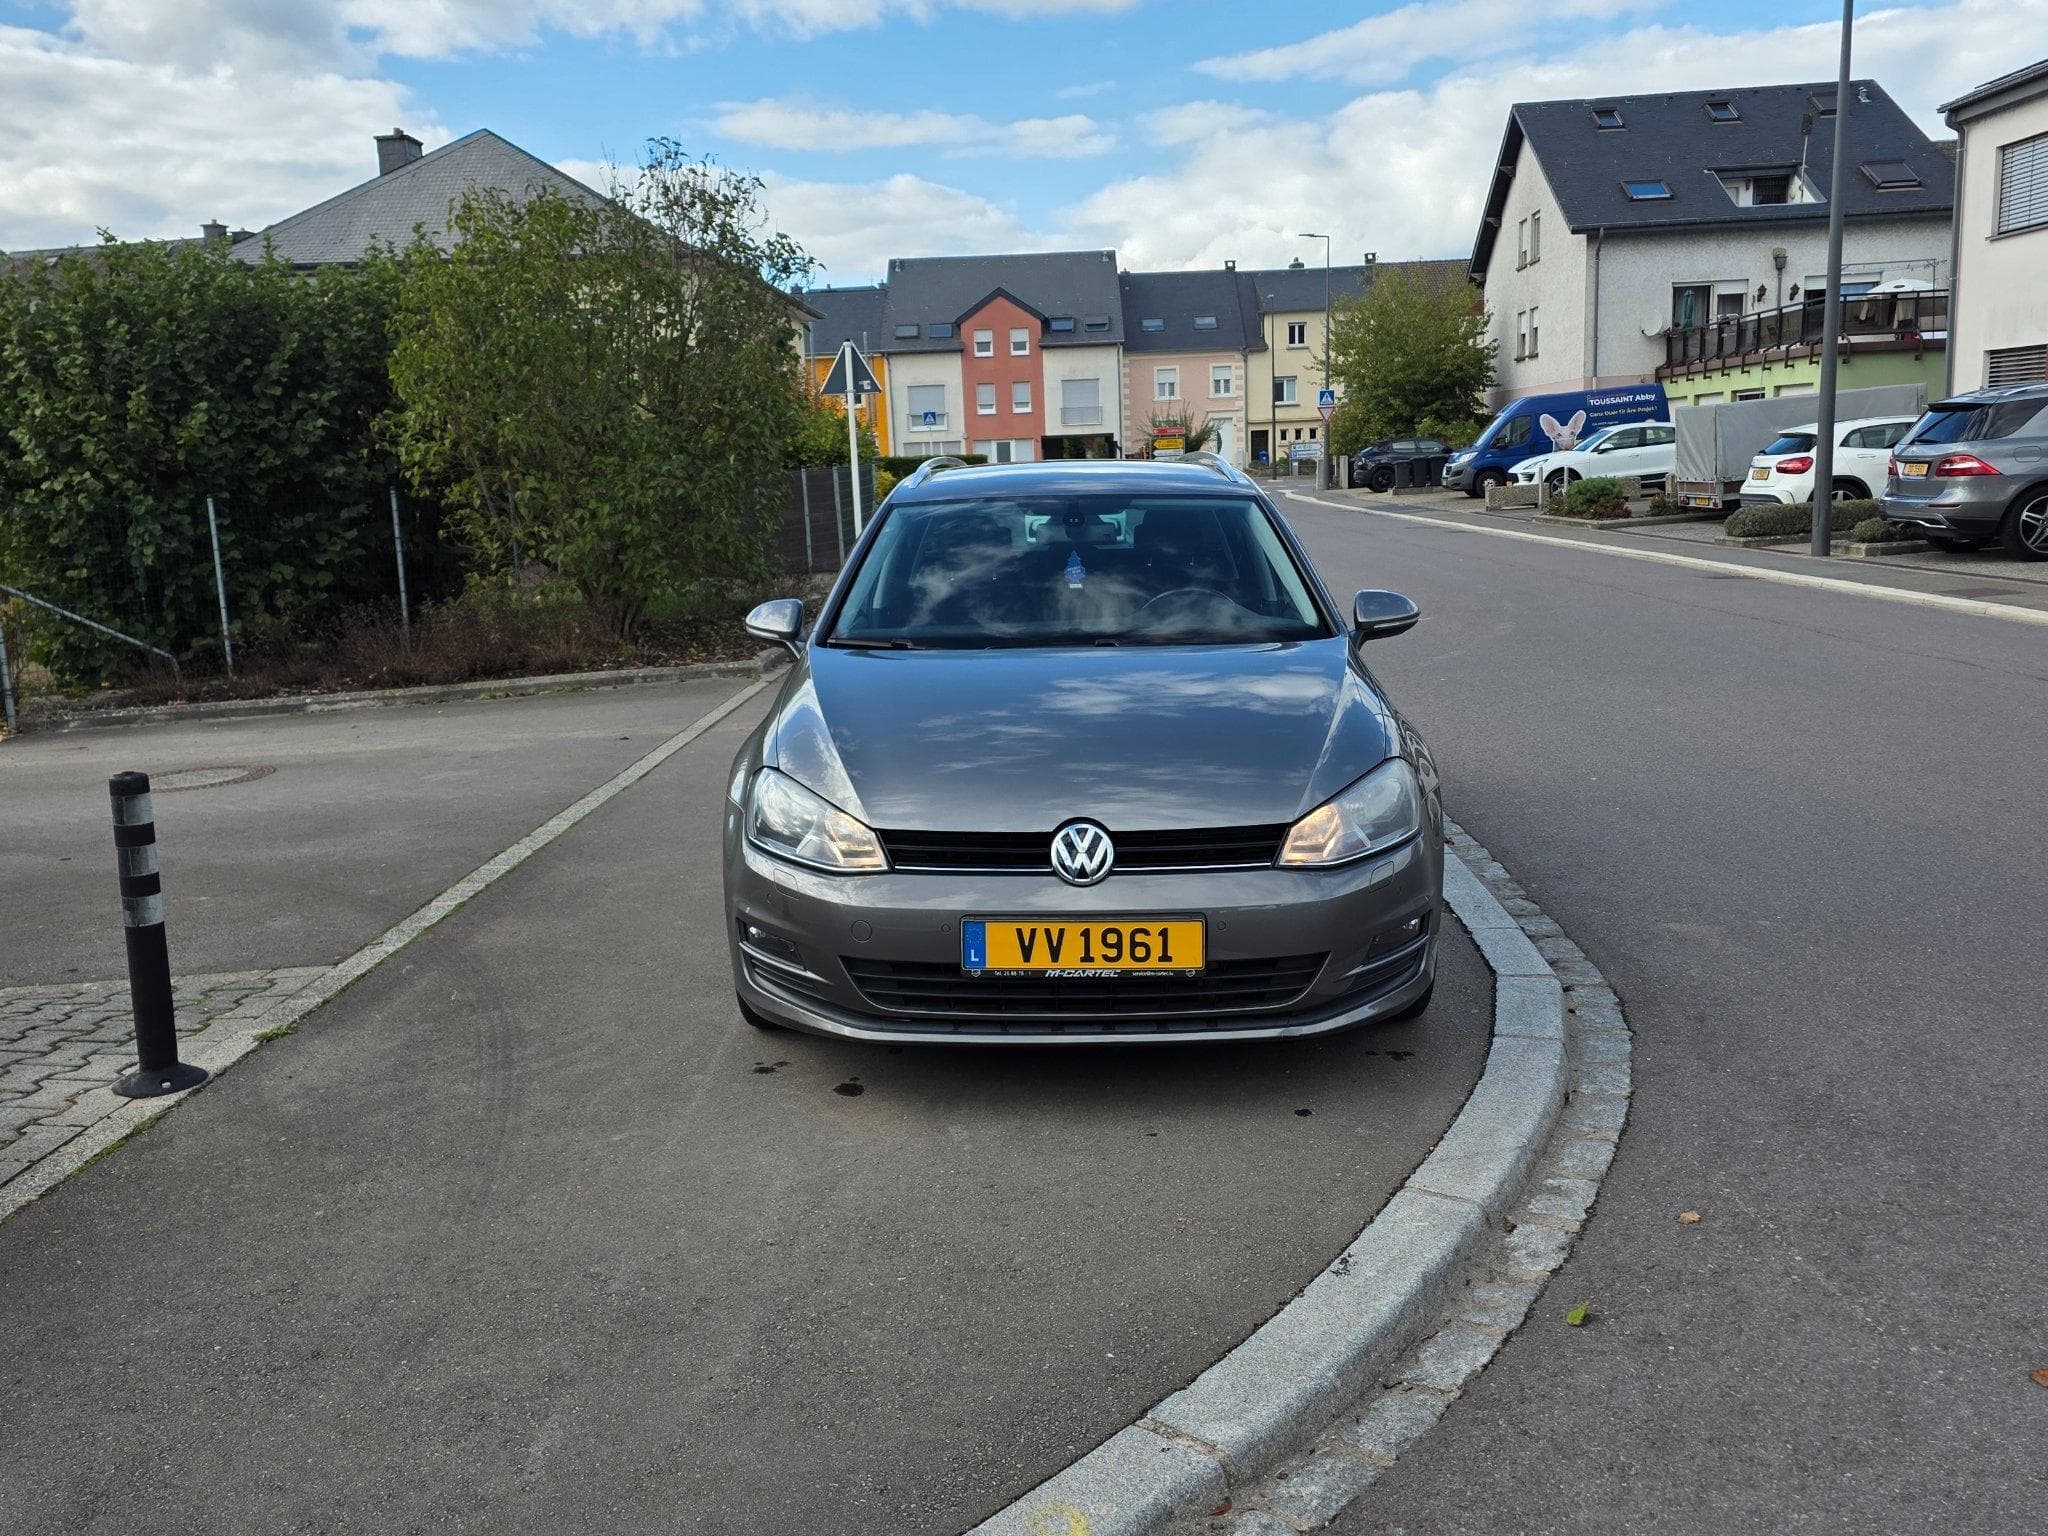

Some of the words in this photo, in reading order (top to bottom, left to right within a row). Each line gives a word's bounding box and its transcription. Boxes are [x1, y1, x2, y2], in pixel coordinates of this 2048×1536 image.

[1589, 395, 1633, 406] TOUSSAINT
[1635, 393, 1656, 402] Abby
[1015, 927, 1066, 963] VV
[1079, 927, 1173, 963] 1961
[970, 949, 979, 962] L
